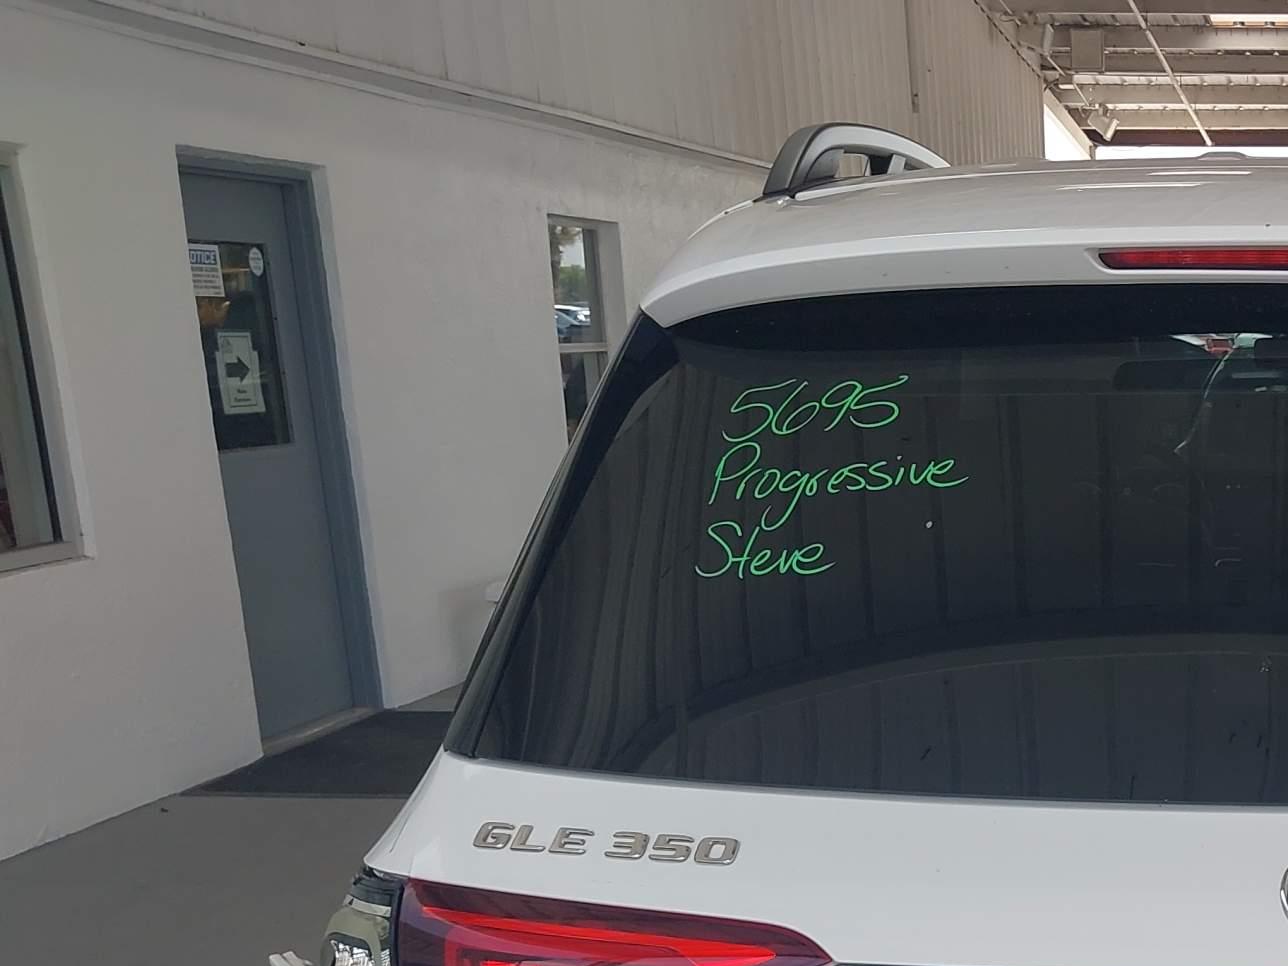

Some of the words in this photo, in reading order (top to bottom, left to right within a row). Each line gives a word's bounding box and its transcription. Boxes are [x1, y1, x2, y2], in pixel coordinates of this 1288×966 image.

[190, 250, 216, 264] OTICE
[721, 374, 909, 442] 5695
[708, 441, 969, 530] Progressive
[695, 521, 836, 579] Steve
[472, 821, 595, 855] GLE
[604, 831, 741, 865] 350
